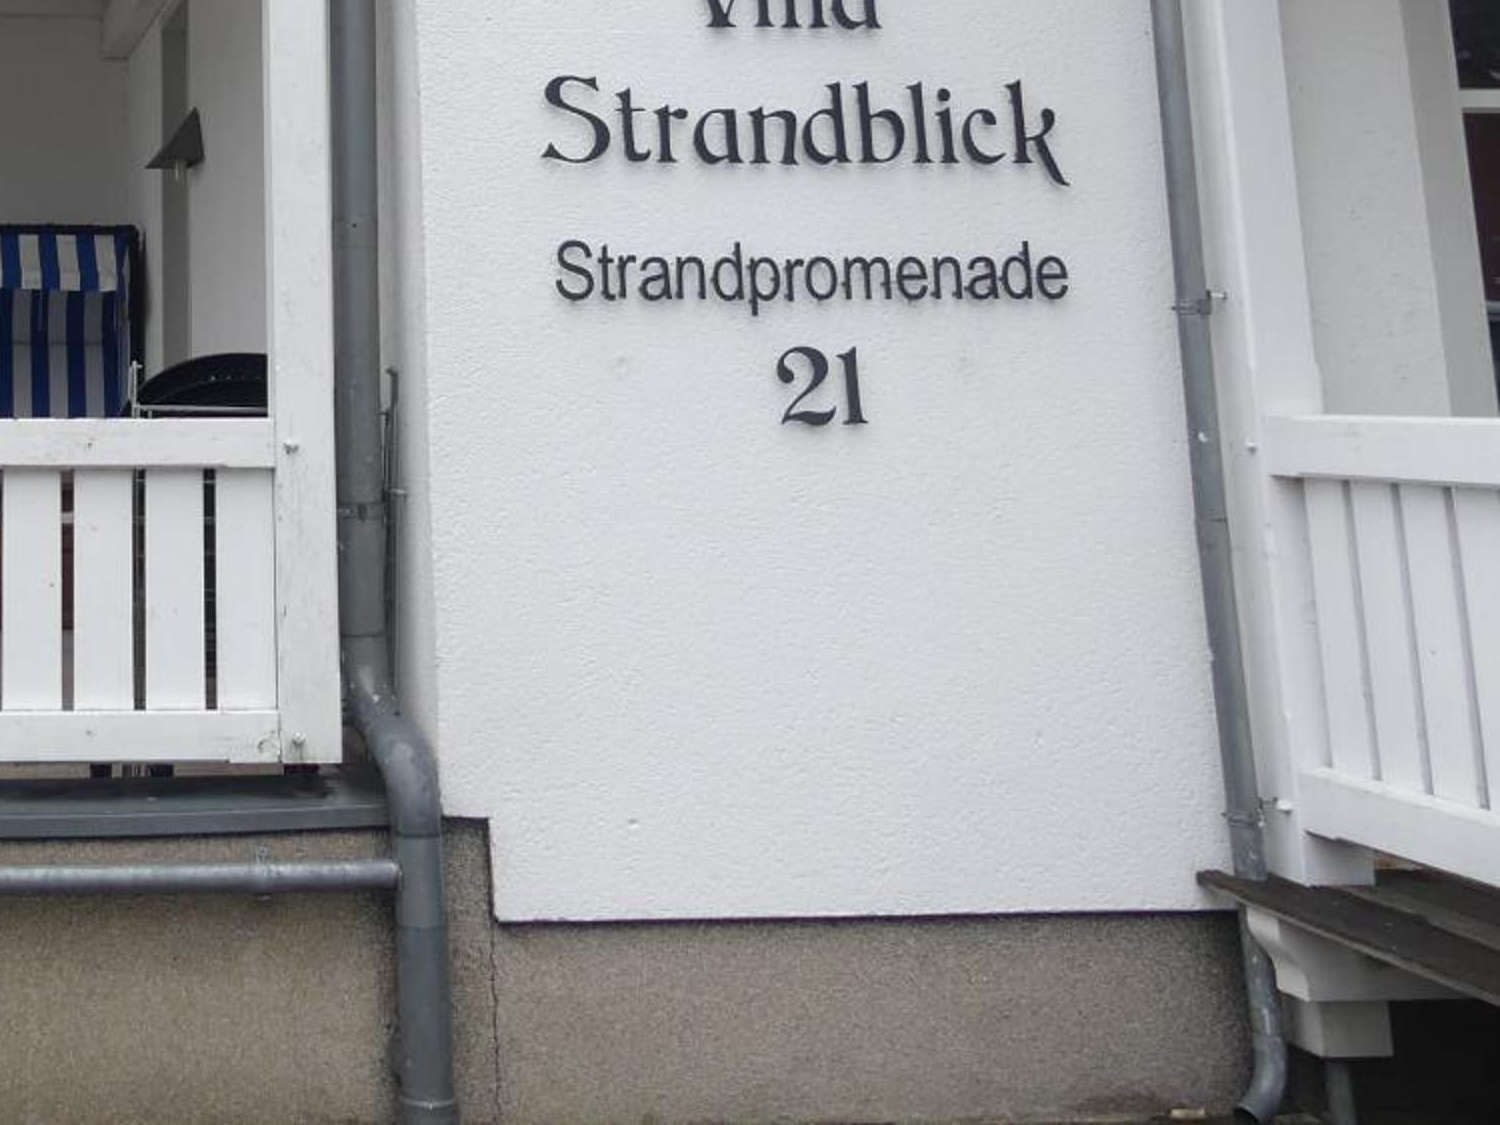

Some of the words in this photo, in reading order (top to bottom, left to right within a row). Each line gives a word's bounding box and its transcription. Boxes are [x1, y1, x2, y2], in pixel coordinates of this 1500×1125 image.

[541, 75, 1070, 187] Strandblick
[555, 240, 1069, 317] Strandpromenade
[776, 346, 869, 428] 21
